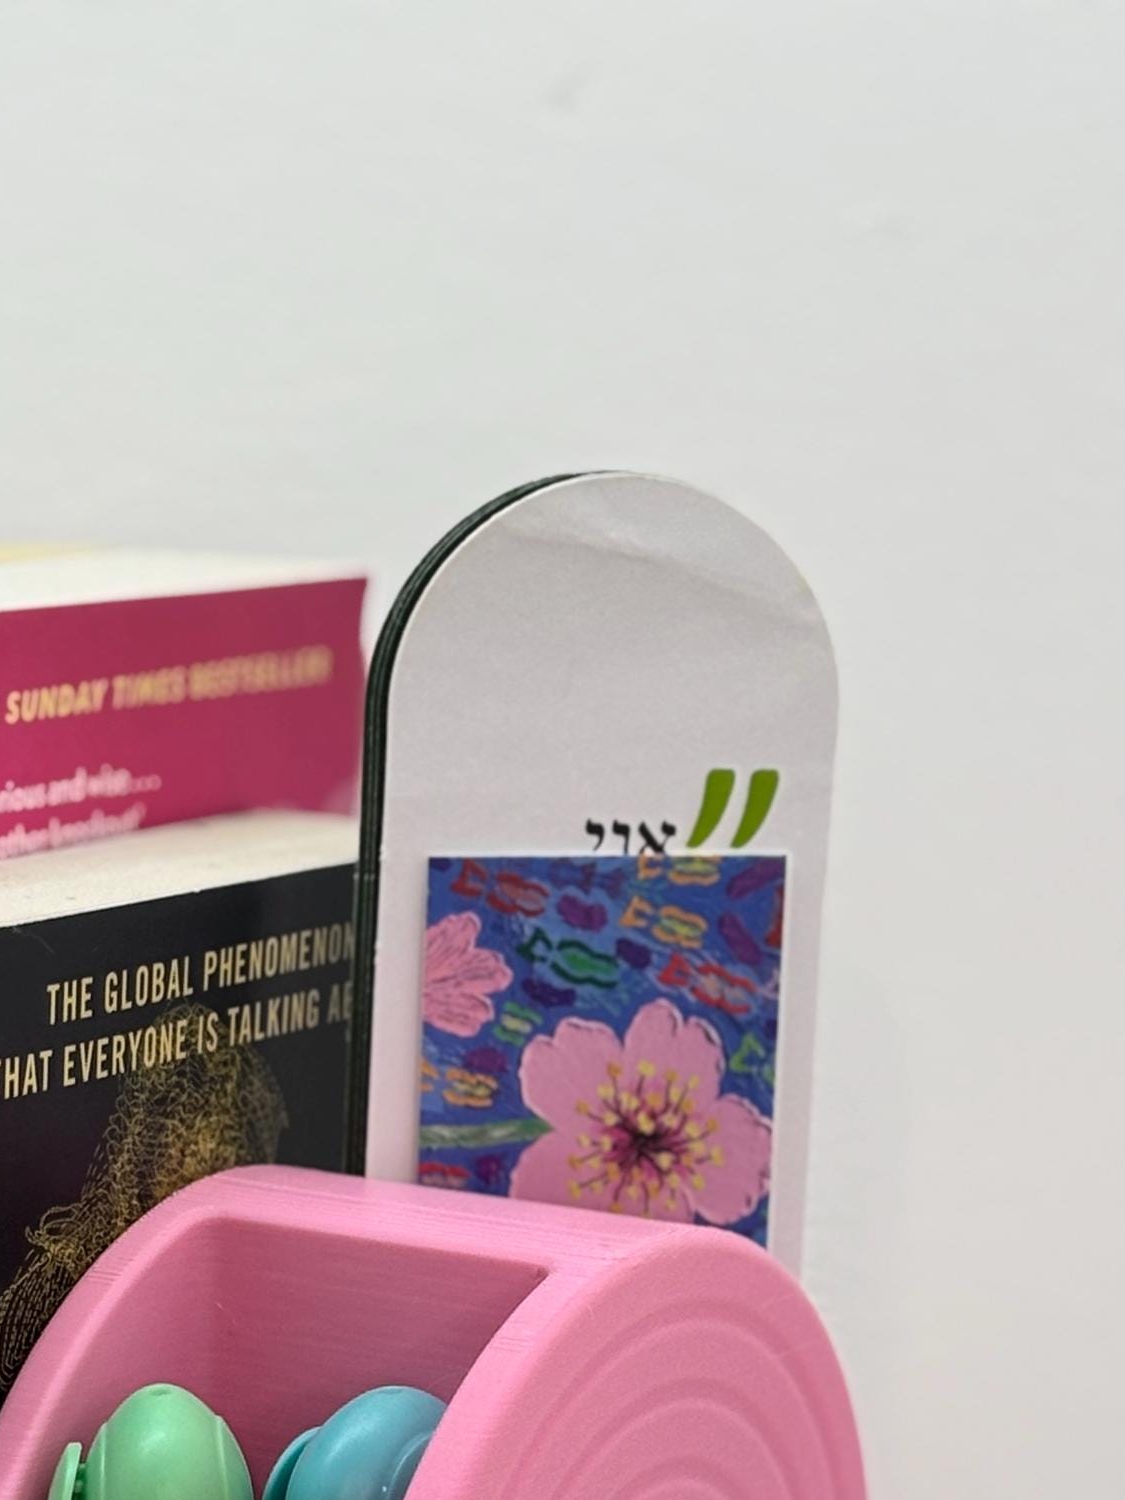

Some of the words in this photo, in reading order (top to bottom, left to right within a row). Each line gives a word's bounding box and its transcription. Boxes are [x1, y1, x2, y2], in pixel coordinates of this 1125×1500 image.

[5, 681, 108, 725] SUNDAY
[112, 665, 187, 710] TIMES
[46, 976, 93, 1026] THE
[104, 955, 193, 1014] GLOBAL
[202, 920, 355, 992] PHENOMENON
[62, 1019, 188, 1087] EVERYONE
[196, 1012, 219, 1055] IS
[227, 989, 319, 1047] TALKING
